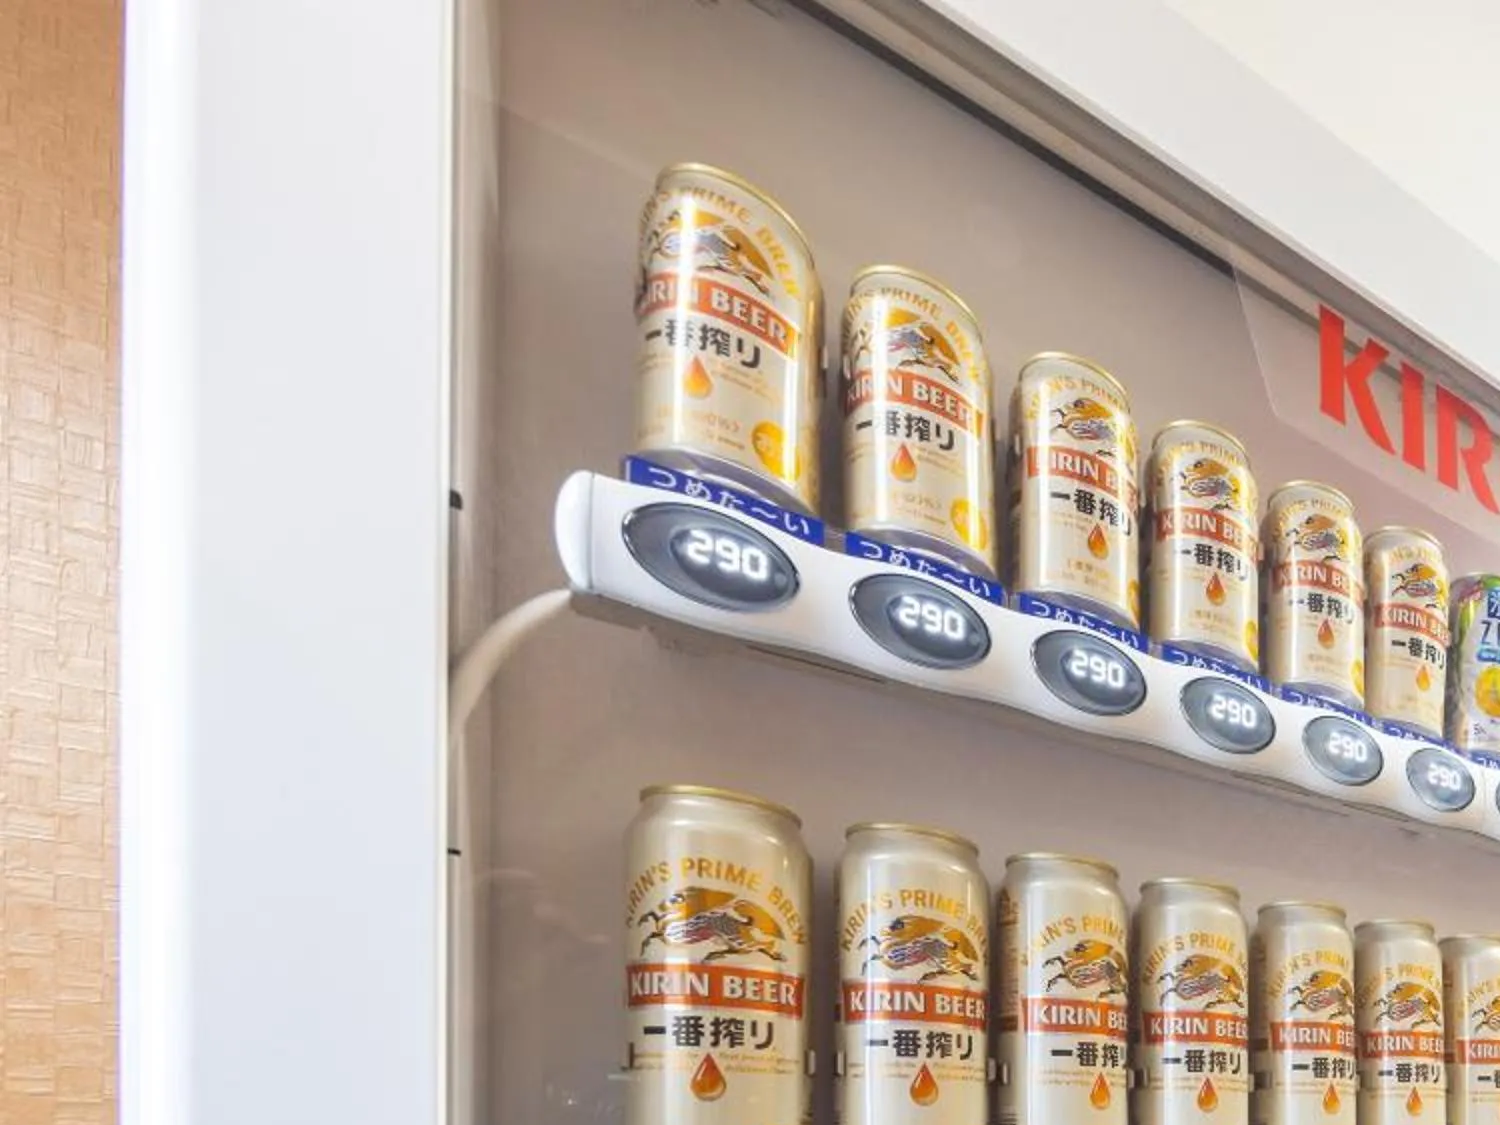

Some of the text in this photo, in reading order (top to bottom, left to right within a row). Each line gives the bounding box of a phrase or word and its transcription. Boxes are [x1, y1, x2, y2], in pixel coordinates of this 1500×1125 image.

[711, 286, 789, 348] BEER
[644, 317, 763, 369] 一番搾り
[846, 369, 975, 422] KIRN BEER
[855, 410, 954, 451] 一番搾り
[1050, 487, 1132, 537] 一番搾り
[1161, 508, 1217, 534] KRIN
[686, 528, 769, 581] 290
[1181, 542, 1248, 580] 一番搾り
[898, 594, 967, 642] 290
[1068, 648, 1126, 690] 290
[1208, 693, 1258, 729] 290
[1326, 730, 1368, 763] 290
[1426, 762, 1463, 791] 290
[681, 857, 765, 891] PRIME
[842, 893, 893, 953] KIRIS
[899, 889, 963, 919] PRIME
[630, 969, 798, 1007] KIRIN BEER
[849, 988, 986, 1020] KIRIN BEER
[642, 1014, 776, 1051] 一番搾り
[1035, 1004, 1101, 1028] KIRIN
[1150, 1018, 1208, 1036] KIRIN
[864, 1028, 975, 1062] 一番搾り
[1279, 1027, 1333, 1044] KIRIN
[1367, 1037, 1414, 1052] KIRIN
[1162, 1049, 1242, 1075] 一番搾り
[1291, 1057, 1358, 1080] 一番搾り
[1378, 1063, 1441, 1084] 一番搾り
